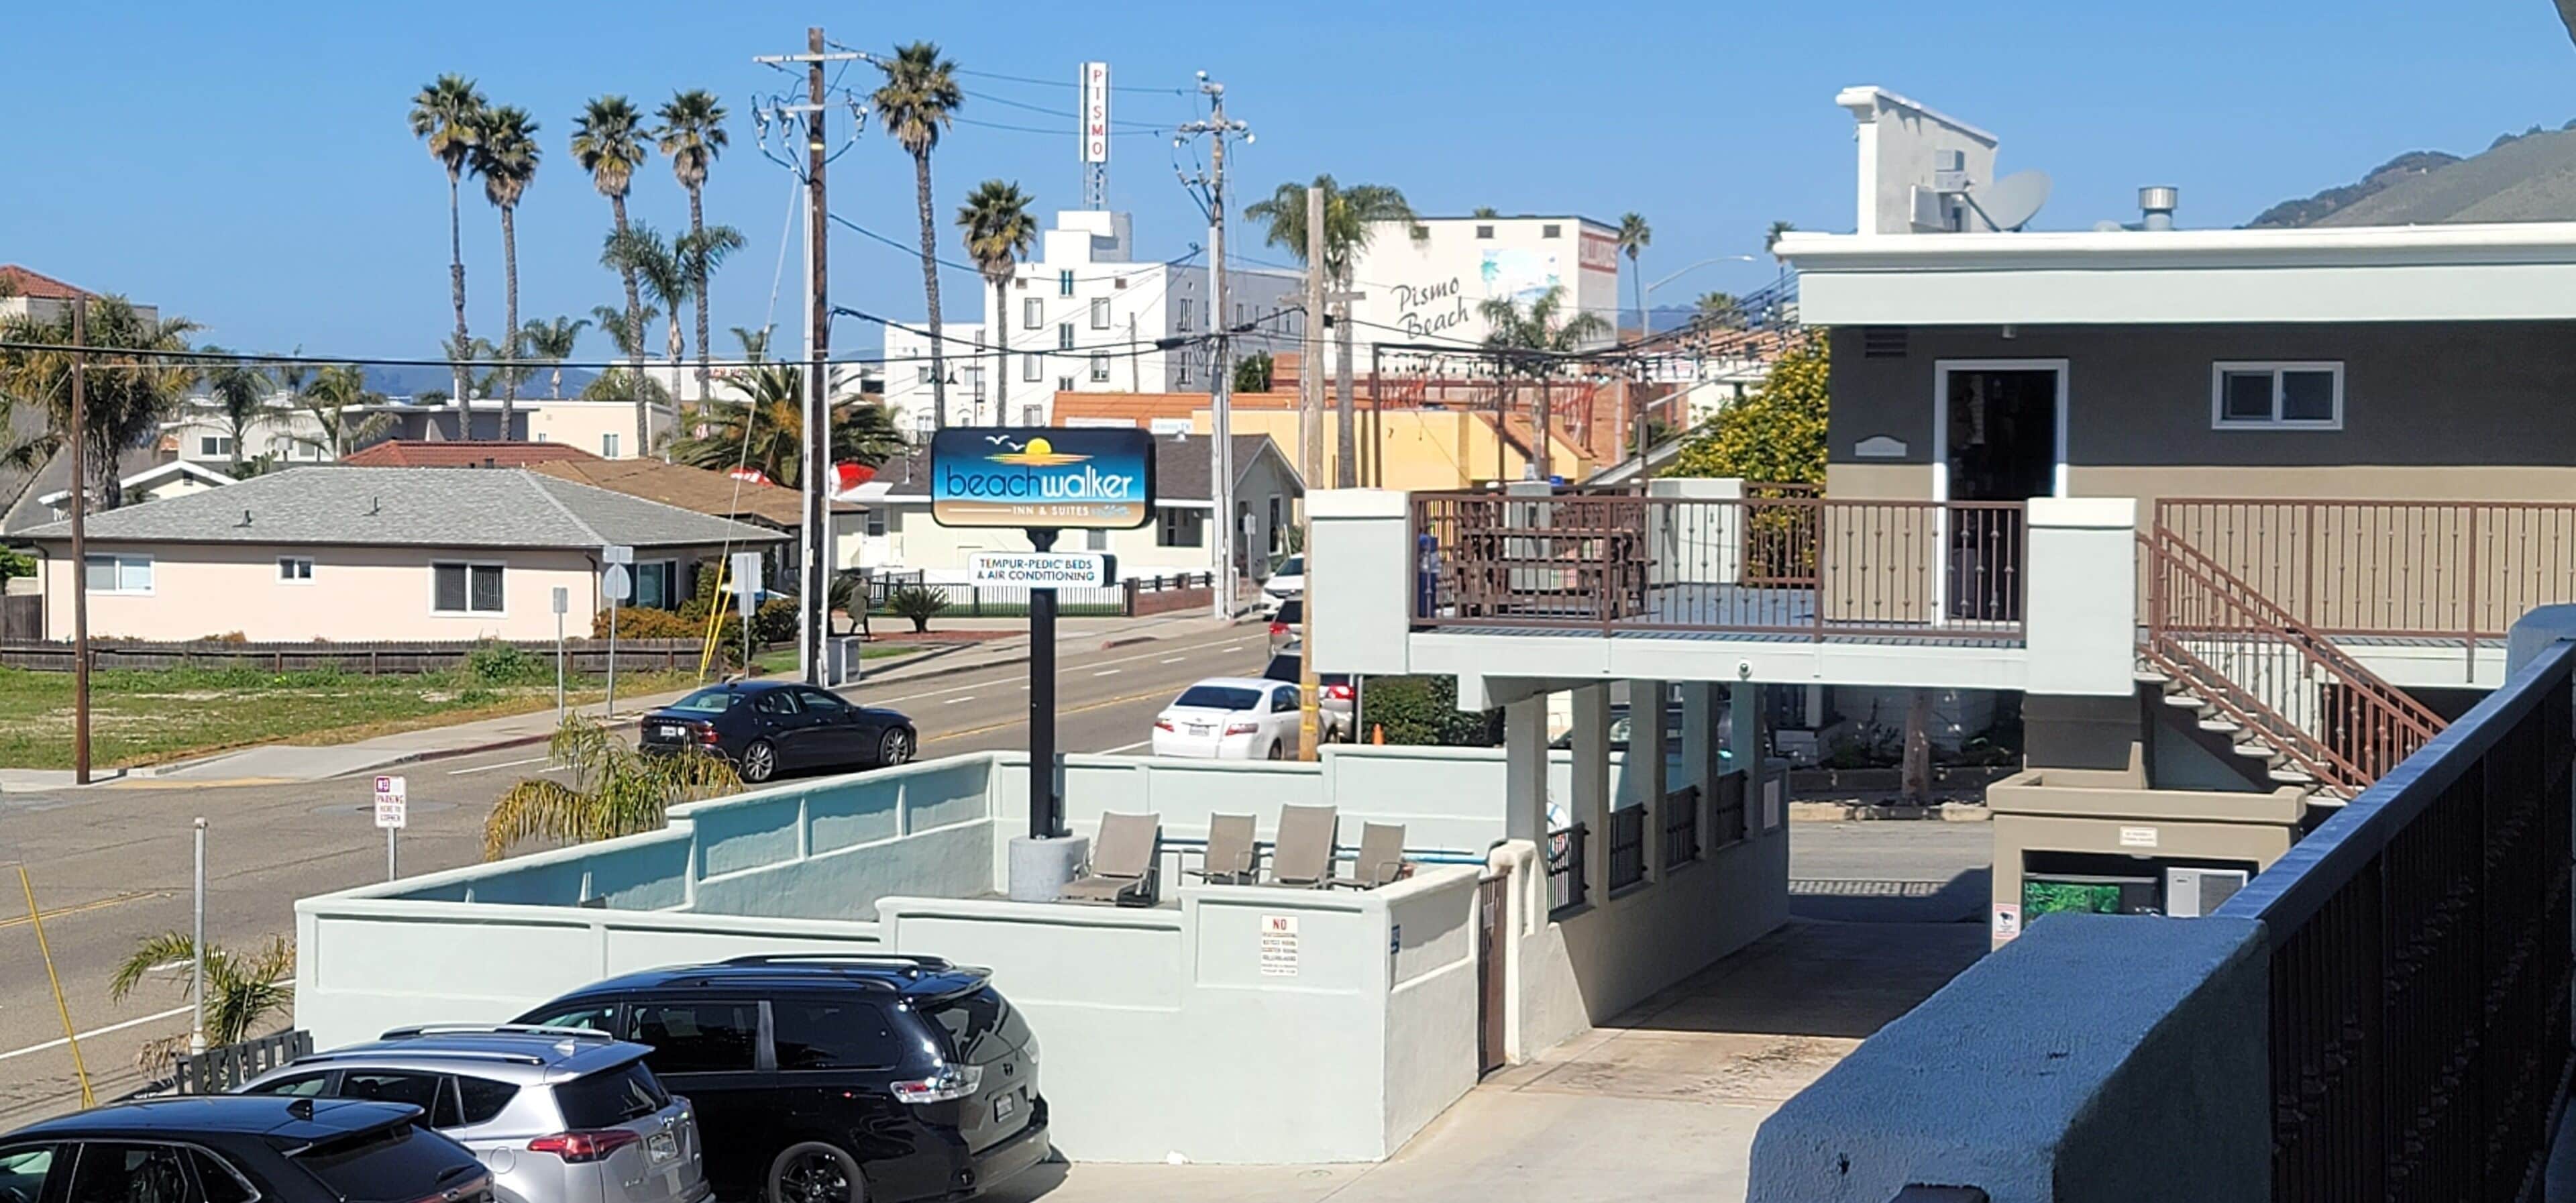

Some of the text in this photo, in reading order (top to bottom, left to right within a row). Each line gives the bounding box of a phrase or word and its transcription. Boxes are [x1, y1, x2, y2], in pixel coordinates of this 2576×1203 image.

[1091, 69, 1104, 155] PISMO
[1390, 276, 1460, 311] Pismo
[1397, 295, 1469, 340] Beach
[946, 464, 1133, 499] beachwalker
[1012, 507, 1034, 515] INN
[1039, 507, 1046, 515] &
[1051, 507, 1089, 516] SUITES
[1065, 559, 1092, 570] BEDS
[977, 571, 1095, 581] & AIR CONDITIONING
[376, 794, 404, 804] PARKING
[1273, 919, 1287, 931] NO
